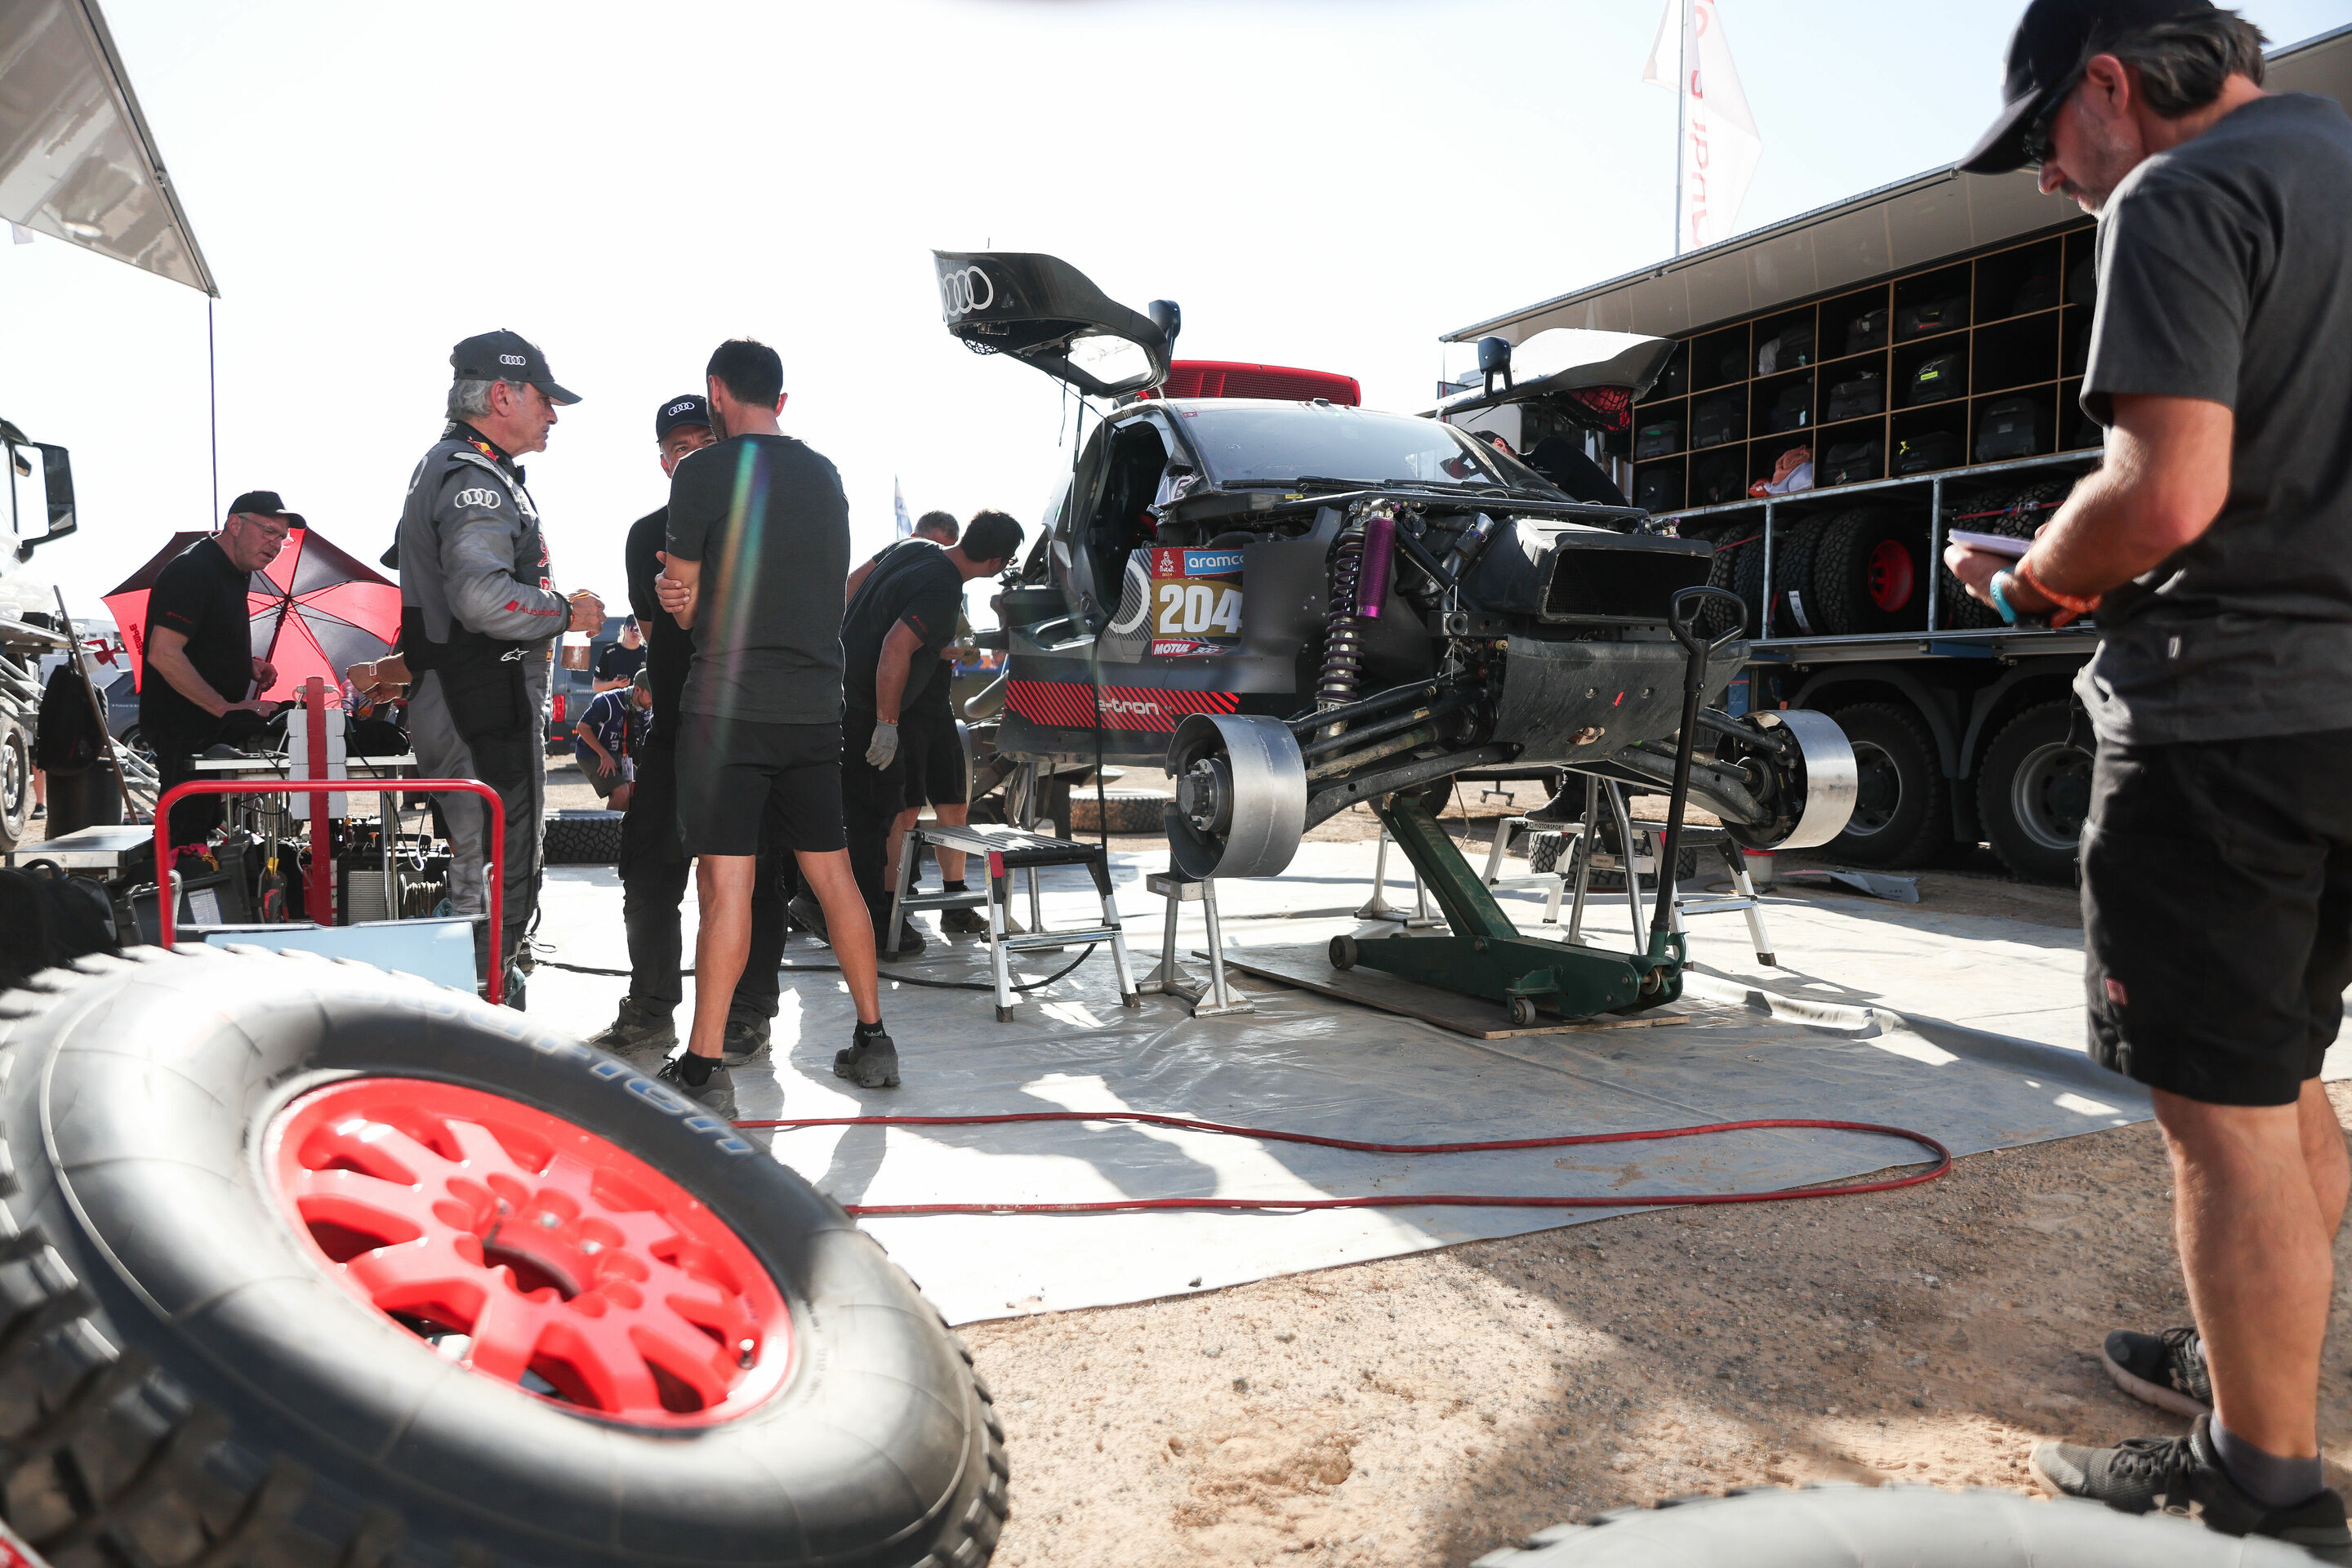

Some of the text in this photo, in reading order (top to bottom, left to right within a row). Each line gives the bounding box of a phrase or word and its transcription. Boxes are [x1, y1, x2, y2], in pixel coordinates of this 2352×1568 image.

[1160, 584, 1243, 634] 204
[1153, 643, 1192, 655] MOTUL
[1098, 697, 1160, 715] e-tron
